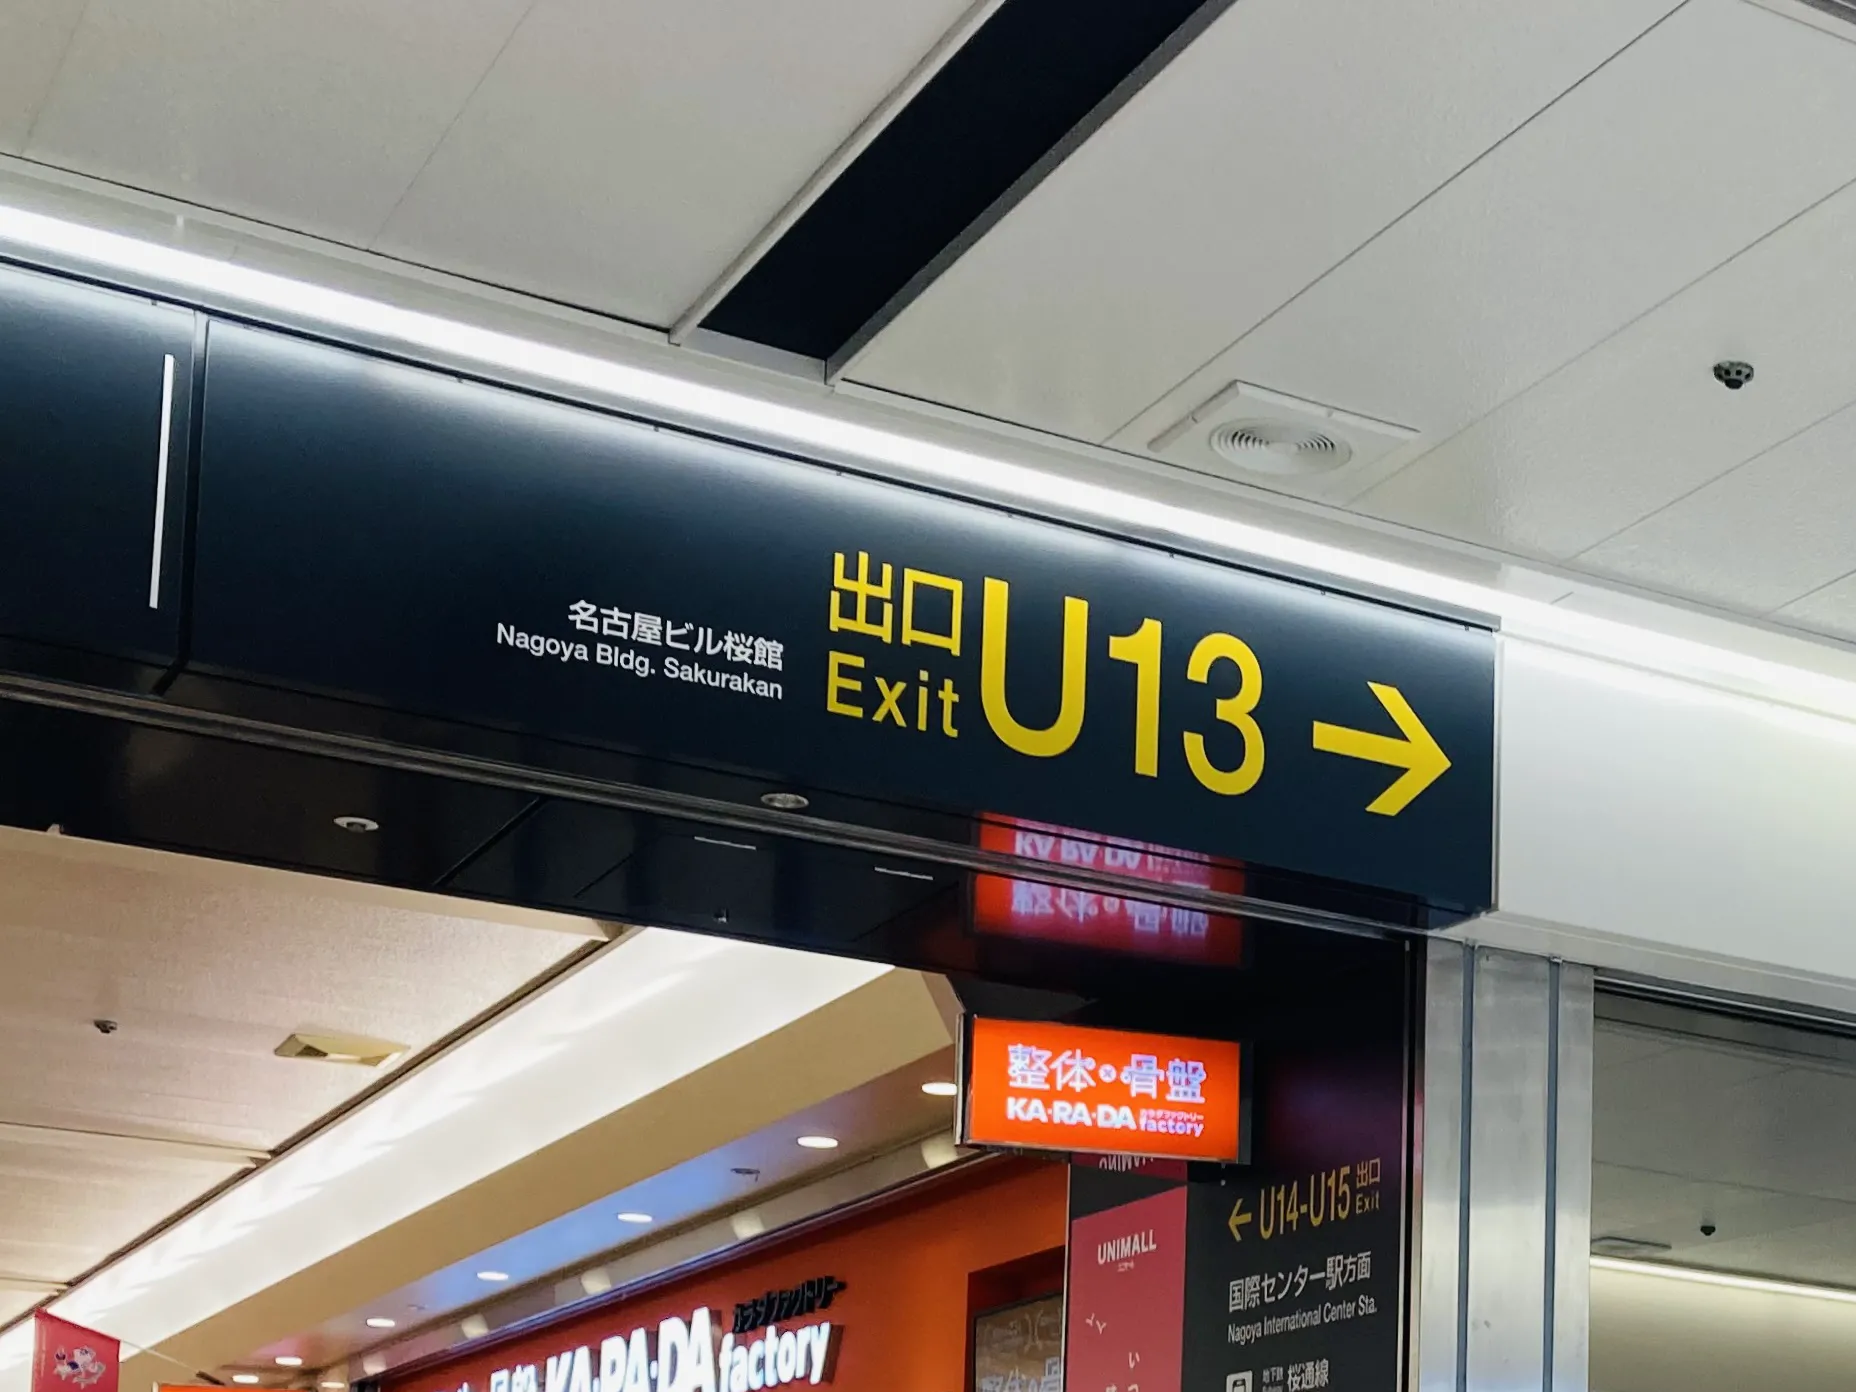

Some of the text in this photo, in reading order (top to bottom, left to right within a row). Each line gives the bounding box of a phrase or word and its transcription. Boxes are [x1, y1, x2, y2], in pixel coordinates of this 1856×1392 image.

[567, 600, 784, 671] 名古屋ビル桜館
[829, 550, 963, 657] 出口
[496, 623, 783, 700] Nagoya Bldg. Sakurakan
[826, 650, 959, 738] Exit
[980, 576, 1266, 796] U13
[1139, 1115, 1204, 1138] factory
[1259, 1165, 1351, 1240] U14-U15
[1356, 1157, 1381, 1189] 出口
[1356, 1190, 1379, 1214] Exit
[1097, 1229, 1158, 1266] UNIMALL
[1229, 1250, 1372, 1314] 国際センター駅方面
[1227, 1294, 1377, 1346] Nagoya International Center Sta.
